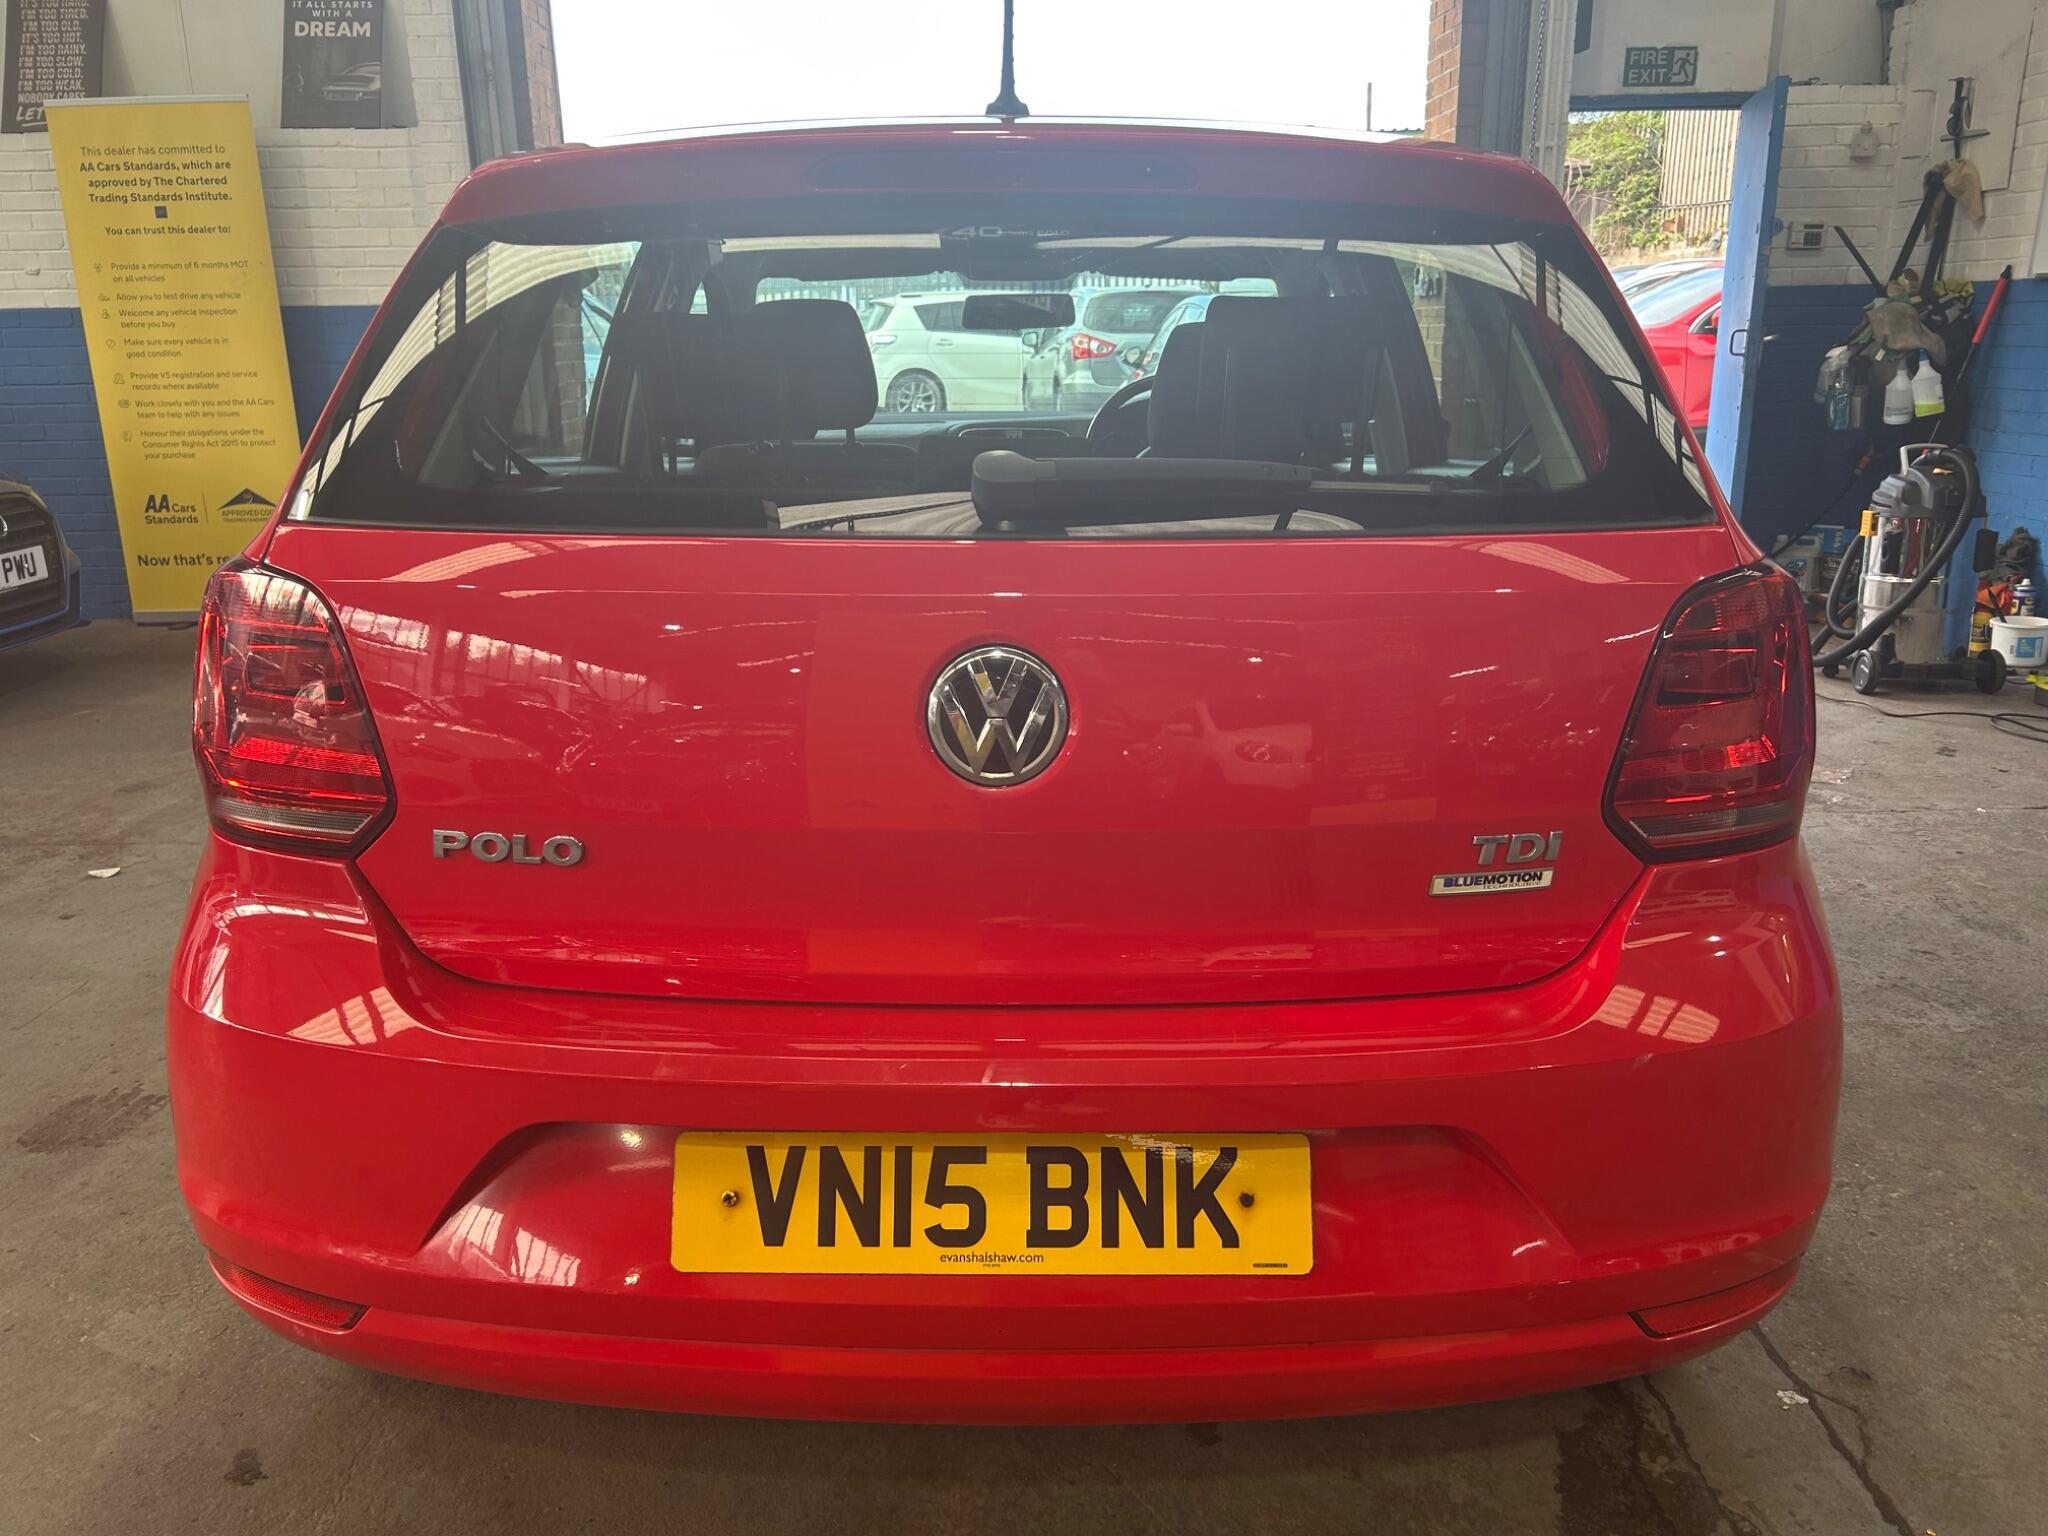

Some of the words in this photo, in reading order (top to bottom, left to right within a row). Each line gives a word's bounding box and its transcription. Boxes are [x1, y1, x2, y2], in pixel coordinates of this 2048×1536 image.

[40, 0, 58, 8] TOO
[331, 1, 373, 9] STARTS
[38, 9, 57, 19] TOO
[41, 21, 58, 31] TOO
[294, 21, 371, 37] DREAM
[42, 33, 60, 43] TOO
[38, 45, 55, 55] TOO
[36, 57, 54, 67] TOO
[56, 56, 84, 67] SLOW.
[1630, 50, 1668, 65] FIRE
[37, 69, 55, 79] TOO
[57, 68, 84, 79] COLD.
[1628, 69, 1668, 83] EXIT
[35, 81, 53, 91] TOO
[56, 80, 85, 91] WEAK.
[17, 92, 55, 103] NOBODY
[80, 146, 102, 156] This
[104, 145, 136, 156] dealer
[137, 145, 154, 155] has
[158, 144, 213, 155] committed
[215, 145, 225, 153] to
[80, 162, 95, 172] AA
[97, 161, 121, 172] Cars
[123, 161, 180, 171] Standards,
[181, 160, 212, 170] which
[215, 161, 231, 170] are
[88, 177, 137, 189] approved
[139, 177, 152, 188] by
[153, 176, 174, 186] The
[175, 176, 228, 185] Chartered
[88, 193, 128, 204] Trading
[130, 192, 183, 202] Standards
[185, 191, 232, 201] Institute.
[105, 226, 123, 236] You
[125, 228, 142, 236] can
[143, 226, 166, 235] trust
[167, 225, 186, 235] this
[187, 224, 216, 234] dealer
[217, 225, 232, 234] to:
[110, 262, 140, 271] Provide
[147, 262, 183, 270] minimum
[184, 261, 192, 270] of
[193, 261, 200, 269] 6
[201, 261, 229, 269] months
[230, 260, 249, 269] MOT
[112, 275, 123, 283] on
[124, 274, 134, 283] all
[135, 274, 166, 282] vehicles
[116, 293, 138, 301] Allow
[139, 294, 153, 302] you
[162, 292, 178, 300] test
[179, 292, 199, 300] drive
[200, 293, 214, 302] any
[215, 291, 241, 299] vehicle
[118, 309, 155, 317] Welcome
[156, 310, 170, 319] any
[171, 308, 198, 316] vehicle
[198, 308, 238, 317] inspection
[120, 320, 146, 328] before
[147, 321, 161, 330] you
[162, 320, 176, 329] buy
[123, 338, 145, 346] Make
[164, 338, 184, 347] every
[185, 337, 212, 345] vehicle
[213, 337, 220, 345] is
[221, 337, 229, 345] in
[126, 350, 146, 360] good
[147, 349, 182, 358] condition
[130, 372, 159, 380] Provide
[172, 371, 215, 380] registration
[216, 371, 230, 379] and
[232, 371, 258, 379] service
[132, 383, 161, 391] records
[162, 382, 185, 390] where
[186, 382, 220, 390] available
[135, 400, 156, 408] Work
[157, 399, 183, 408] closely
[183, 399, 200, 407] with
[201, 400, 215, 408] you
[217, 399, 231, 407] and
[232, 398, 244, 406] the
[245, 398, 257, 406] AA
[257, 398, 275, 406] Cars
[137, 411, 156, 419] team
[166, 410, 183, 420] help
[184, 410, 200, 418] with
[202, 411, 216, 419] any
[217, 410, 240, 418] issues
[140, 429, 172, 437] Honour
[173, 429, 187, 437] their
[187, 429, 229, 438] obligations
[230, 428, 251, 436] under
[252, 428, 265, 436] the
[142, 440, 181, 449] Consumer
[181, 440, 205, 449] Rights
[221, 439, 239, 447] 2015
[249, 439, 277, 448] protect
[144, 452, 161, 460] your
[162, 451, 196, 460] purchase
[144, 494, 170, 513] AA
[171, 503, 197, 513] Cars
[145, 514, 199, 525] Standards
[137, 554, 170, 567] Now
[173, 554, 214, 566] that's
[1, 552, 37, 583] PWU
[432, 829, 583, 867] POLO
[1472, 831, 1563, 865] TDI
[1443, 871, 1543, 888] BLUEMOTION
[745, 1145, 988, 1248] VN15
[1025, 1146, 1241, 1249] BNK
[940, 1252, 1044, 1263] evanshalshaw.com
